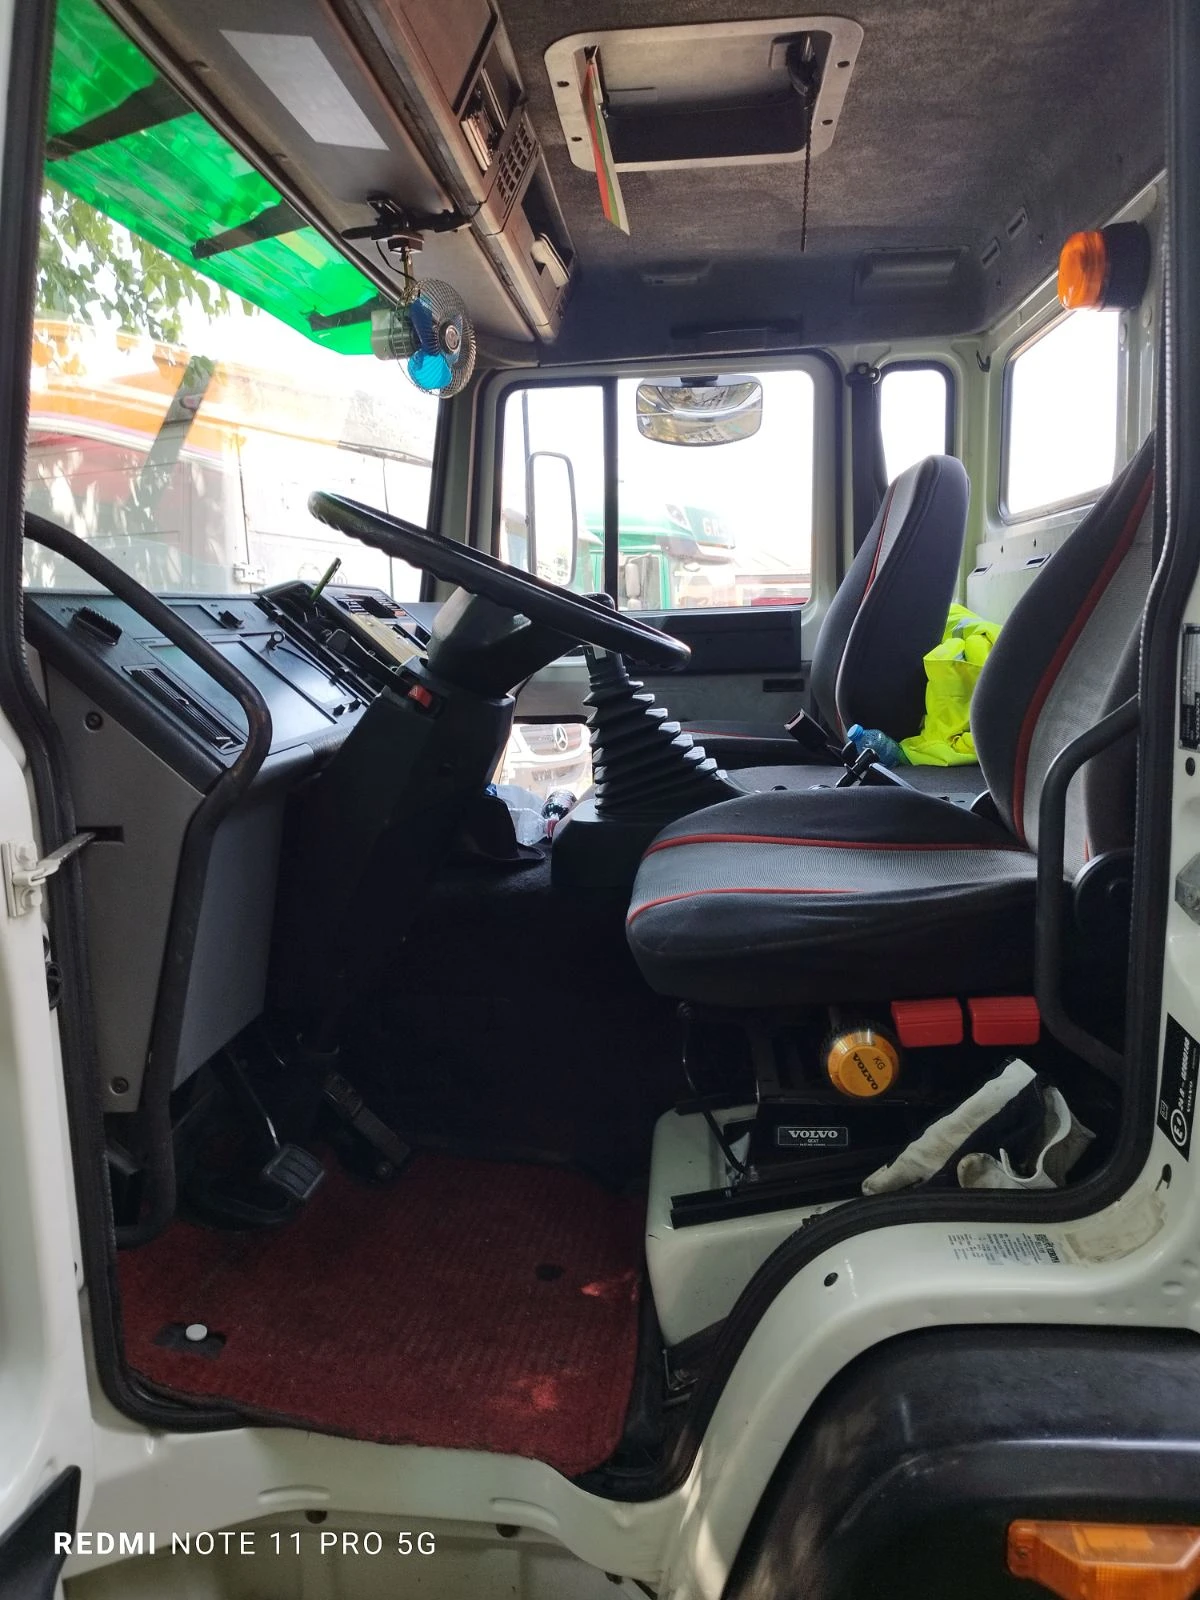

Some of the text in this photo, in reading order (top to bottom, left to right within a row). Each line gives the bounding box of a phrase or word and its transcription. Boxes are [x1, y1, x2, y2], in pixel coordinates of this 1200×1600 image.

[873, 1056, 886, 1070] KG
[853, 1052, 878, 1090] VOLVO
[788, 1130, 838, 1138] VOLVO
